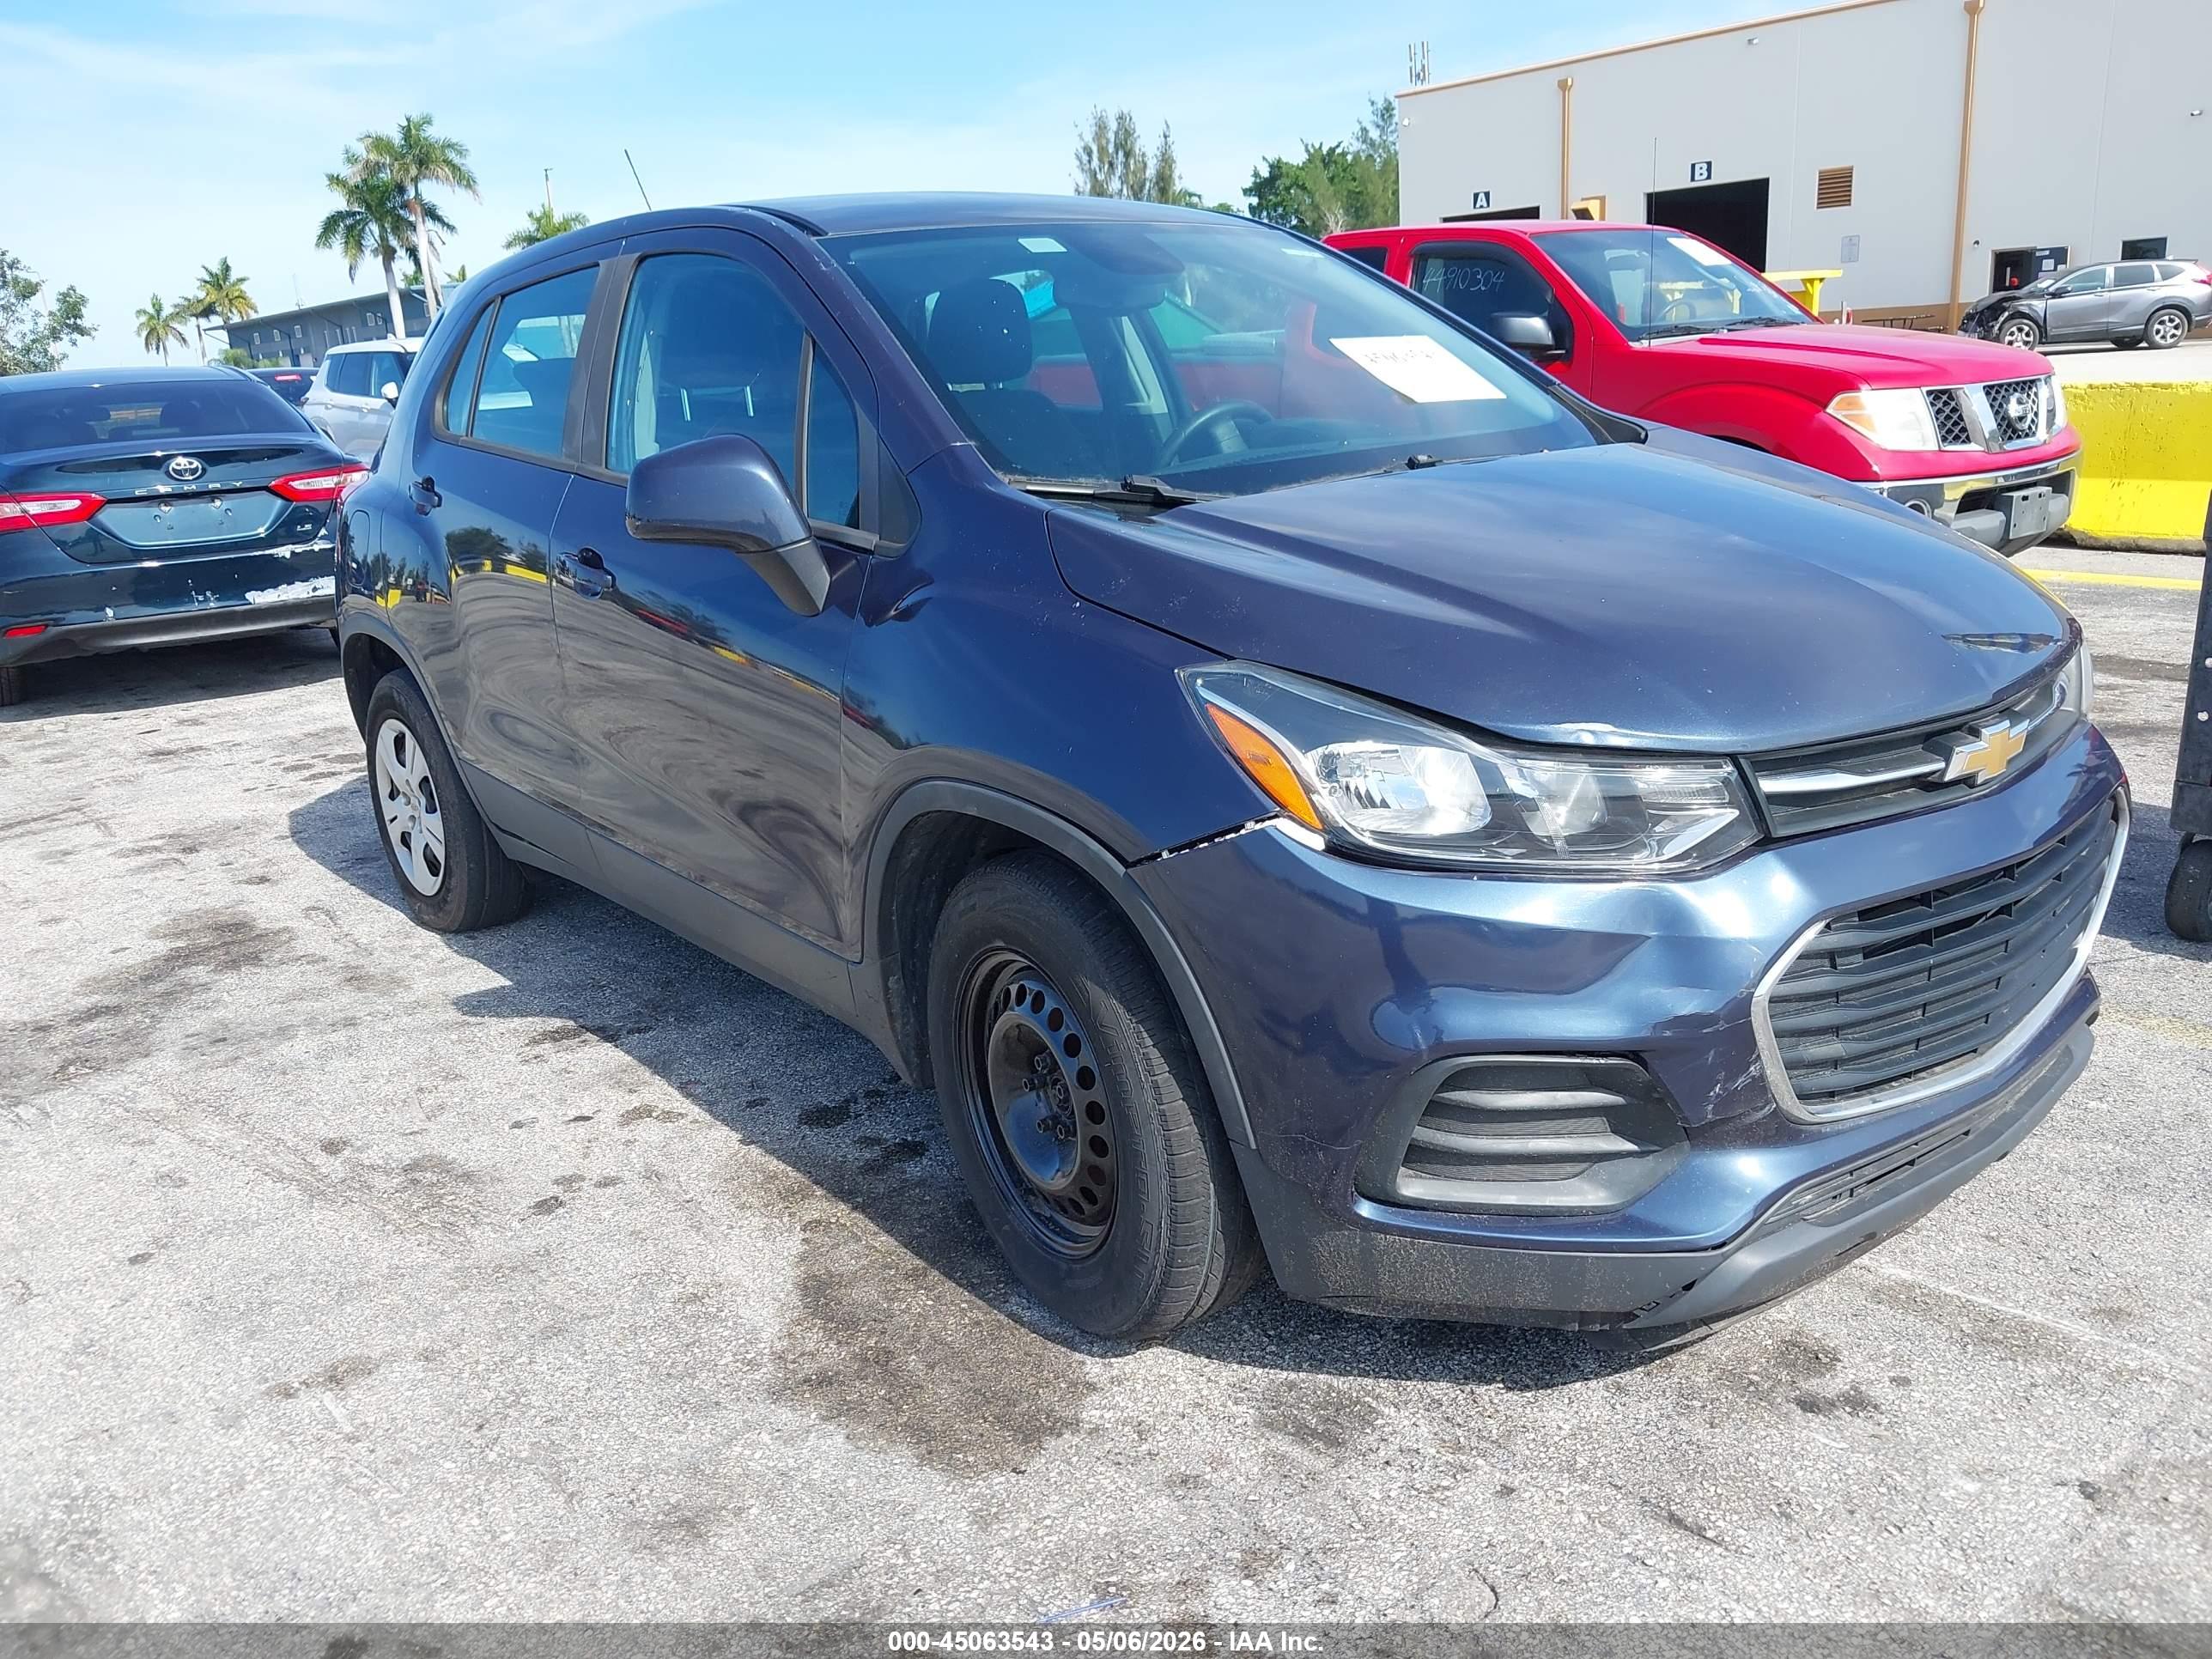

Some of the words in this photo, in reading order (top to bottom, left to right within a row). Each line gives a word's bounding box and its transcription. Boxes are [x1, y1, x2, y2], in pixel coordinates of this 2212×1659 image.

[1694, 162, 1708, 181] B
[1475, 192, 1488, 208] A
[134, 482, 243, 495] CAMRY
